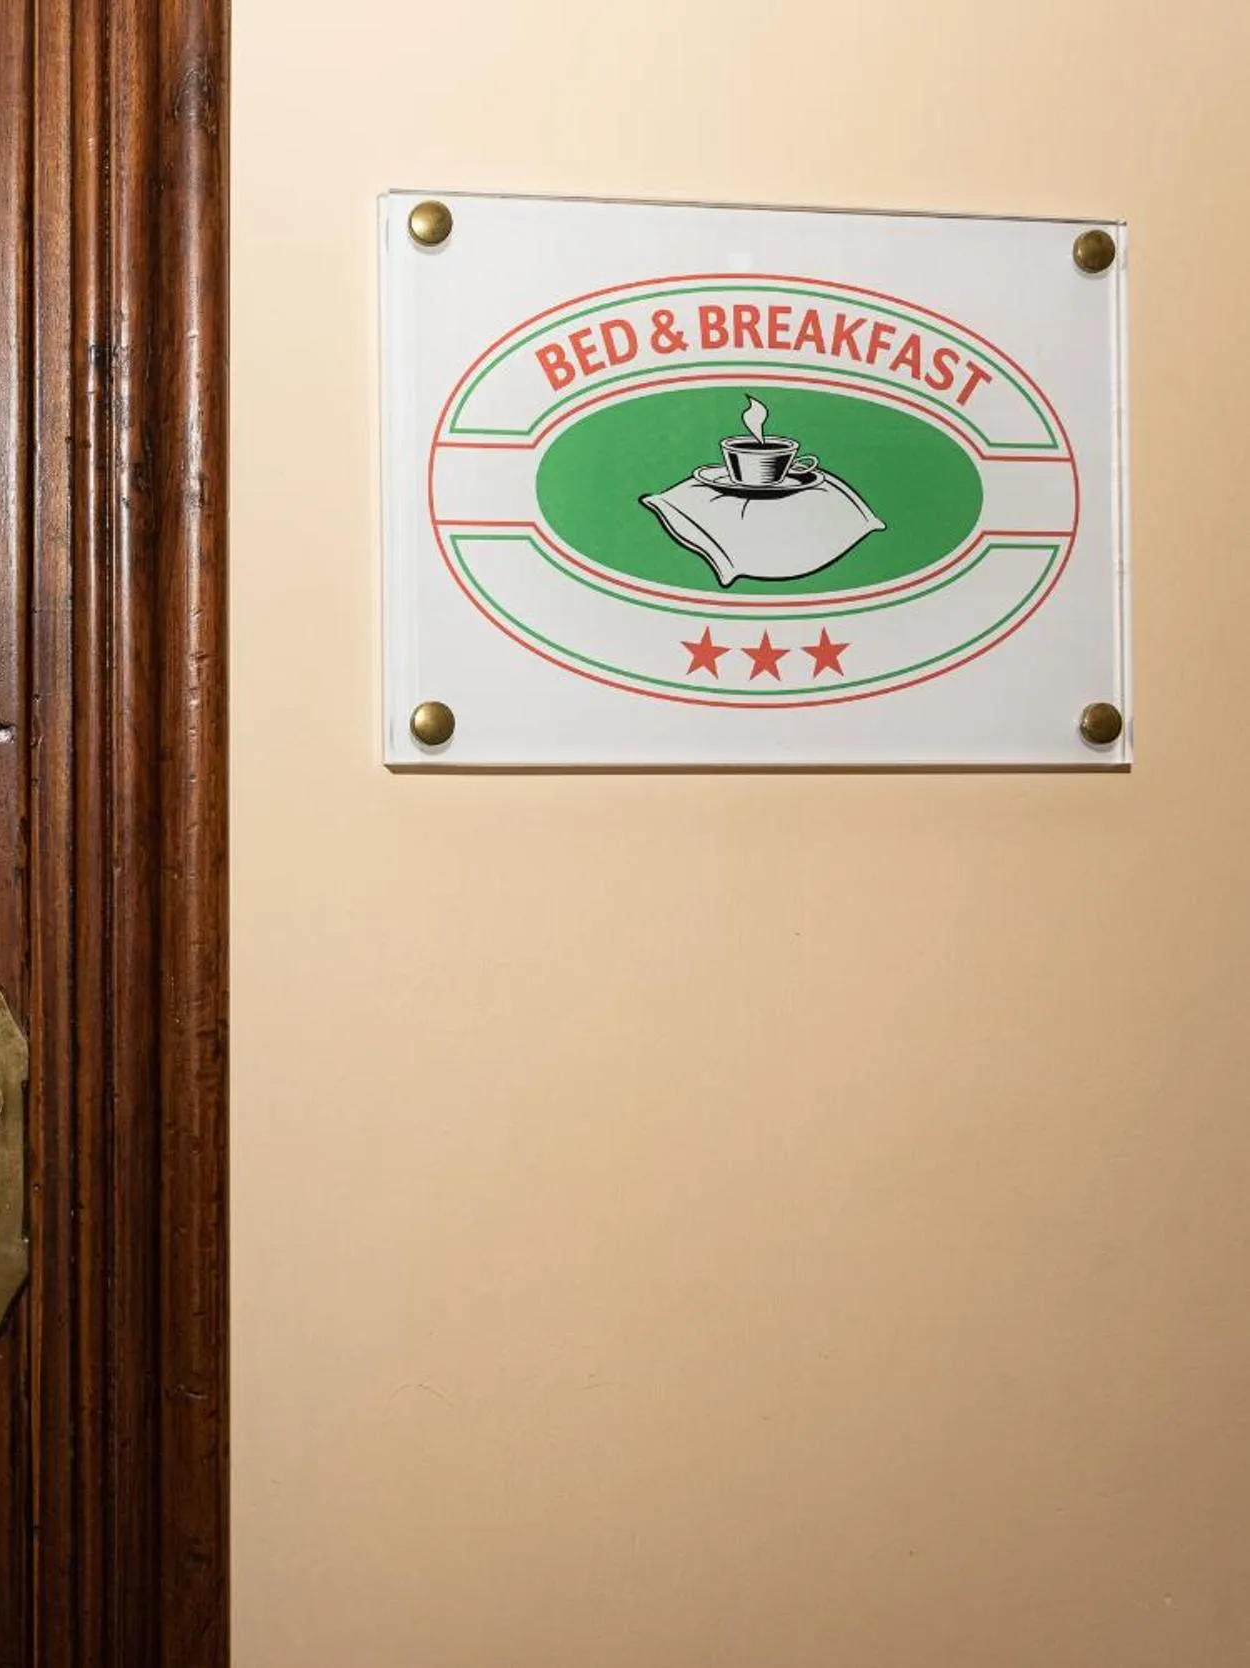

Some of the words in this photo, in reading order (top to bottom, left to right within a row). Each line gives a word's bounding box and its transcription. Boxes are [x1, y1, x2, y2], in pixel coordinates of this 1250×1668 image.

[534, 318, 639, 392] BED
[650, 309, 689, 354] &
[698, 303, 993, 406] BREAKFAST
